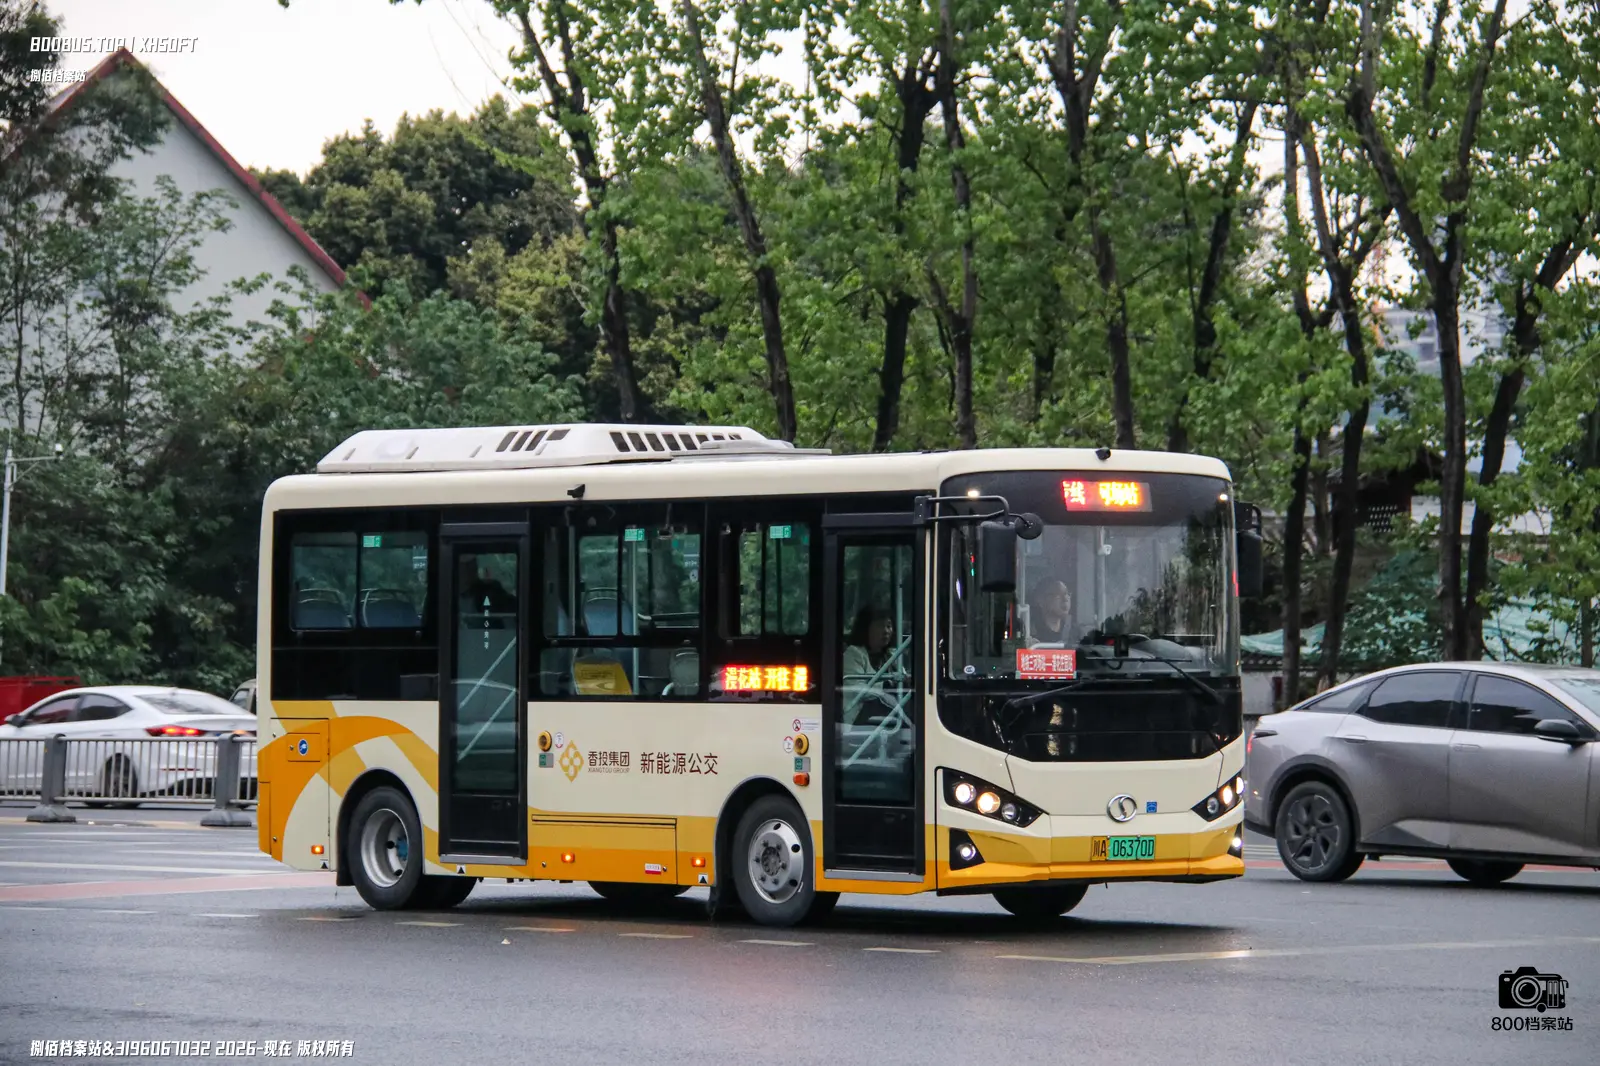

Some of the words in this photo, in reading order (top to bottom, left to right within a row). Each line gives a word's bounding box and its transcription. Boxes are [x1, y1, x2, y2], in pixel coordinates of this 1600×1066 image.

[588, 751, 630, 767] 香投集团
[640, 751, 719, 776] 新能源公交
